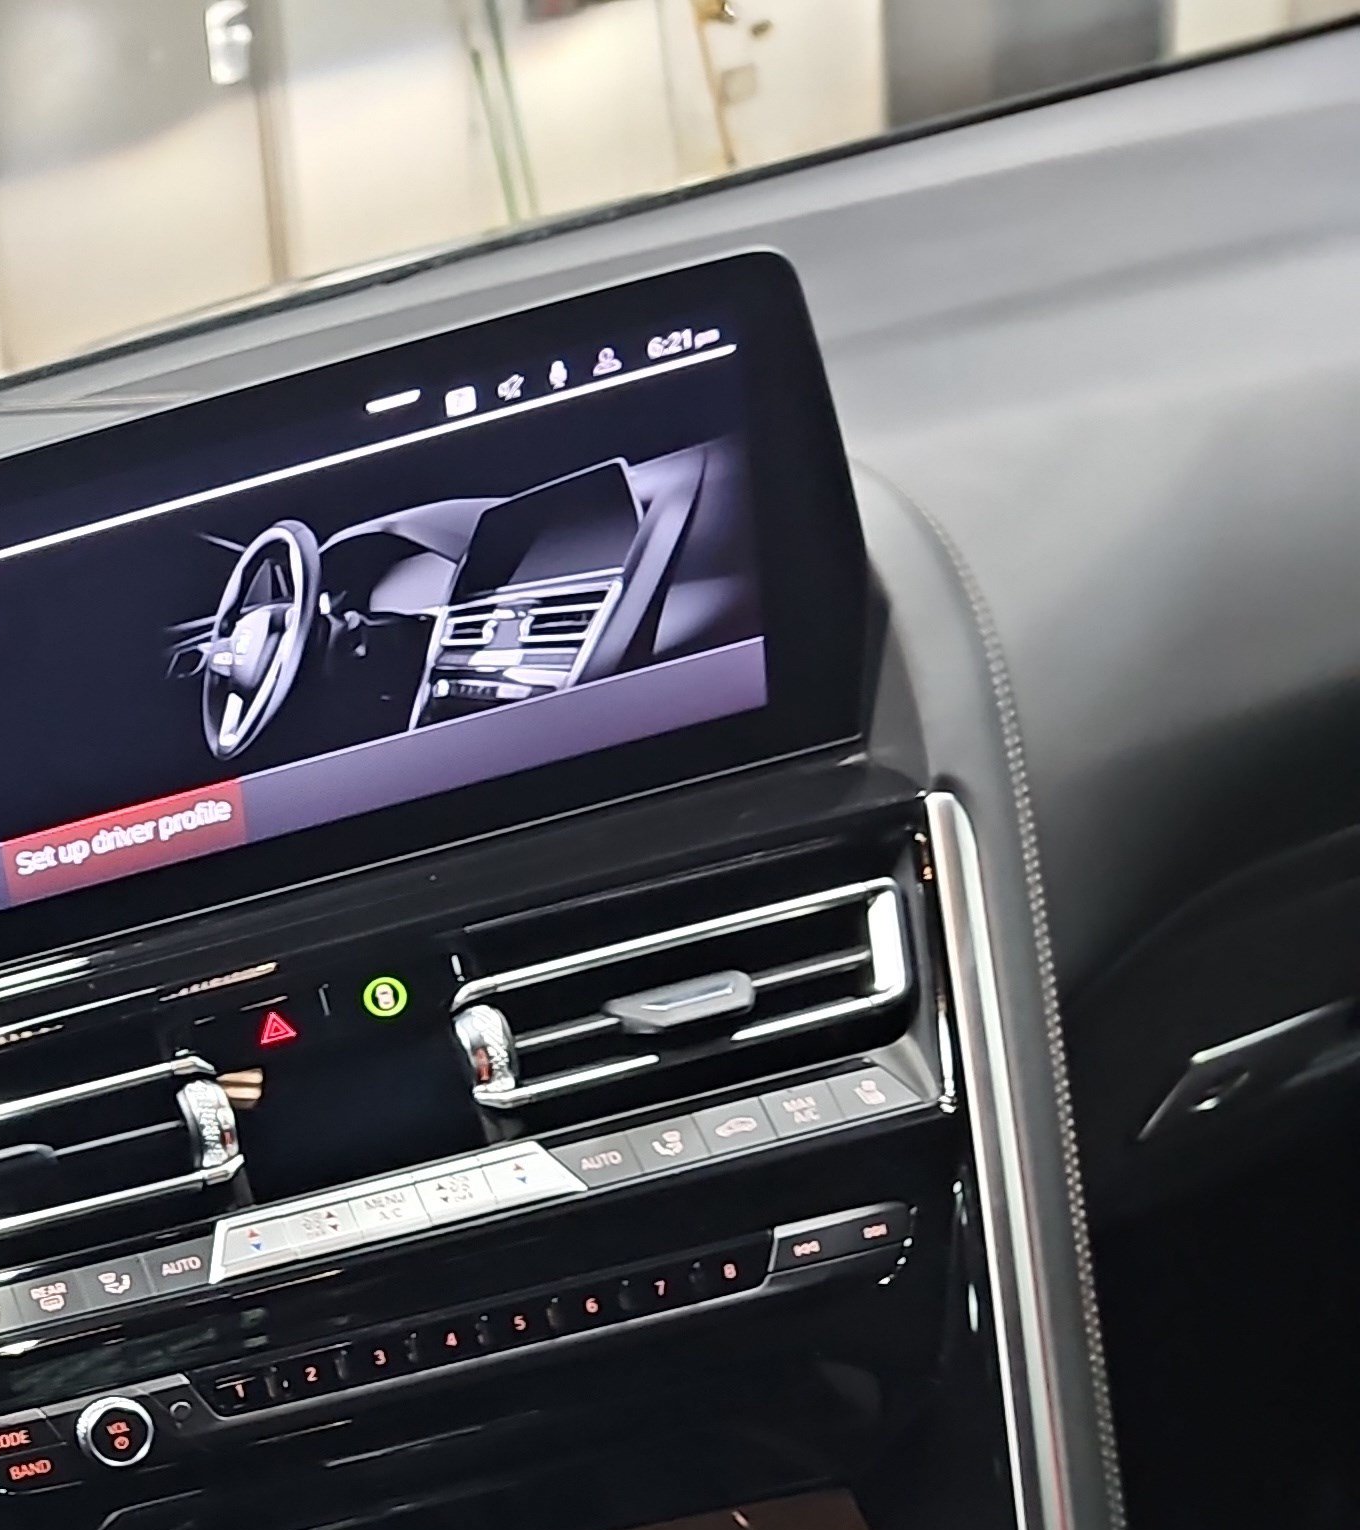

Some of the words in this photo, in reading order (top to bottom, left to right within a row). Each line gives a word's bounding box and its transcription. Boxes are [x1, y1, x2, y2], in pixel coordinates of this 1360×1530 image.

[647, 328, 692, 360] 6:21
[15, 844, 57, 876] Set
[57, 838, 91, 866] up
[91, 820, 156, 857] driver
[157, 798, 233, 842] profile
[581, 1151, 623, 1171] AUTO
[161, 1256, 201, 1277] AUTO
[723, 1263, 737, 1279] 8
[30, 1281, 68, 1300] REAR
[654, 1279, 666, 1296] 7
[585, 1297, 599, 1314] 6
[513, 1315, 527, 1331] 5
[444, 1331, 458, 1348] 4
[373, 1349, 387, 1365] 3
[305, 1366, 319, 1383] 2
[8, 1459, 52, 1480] BAND
